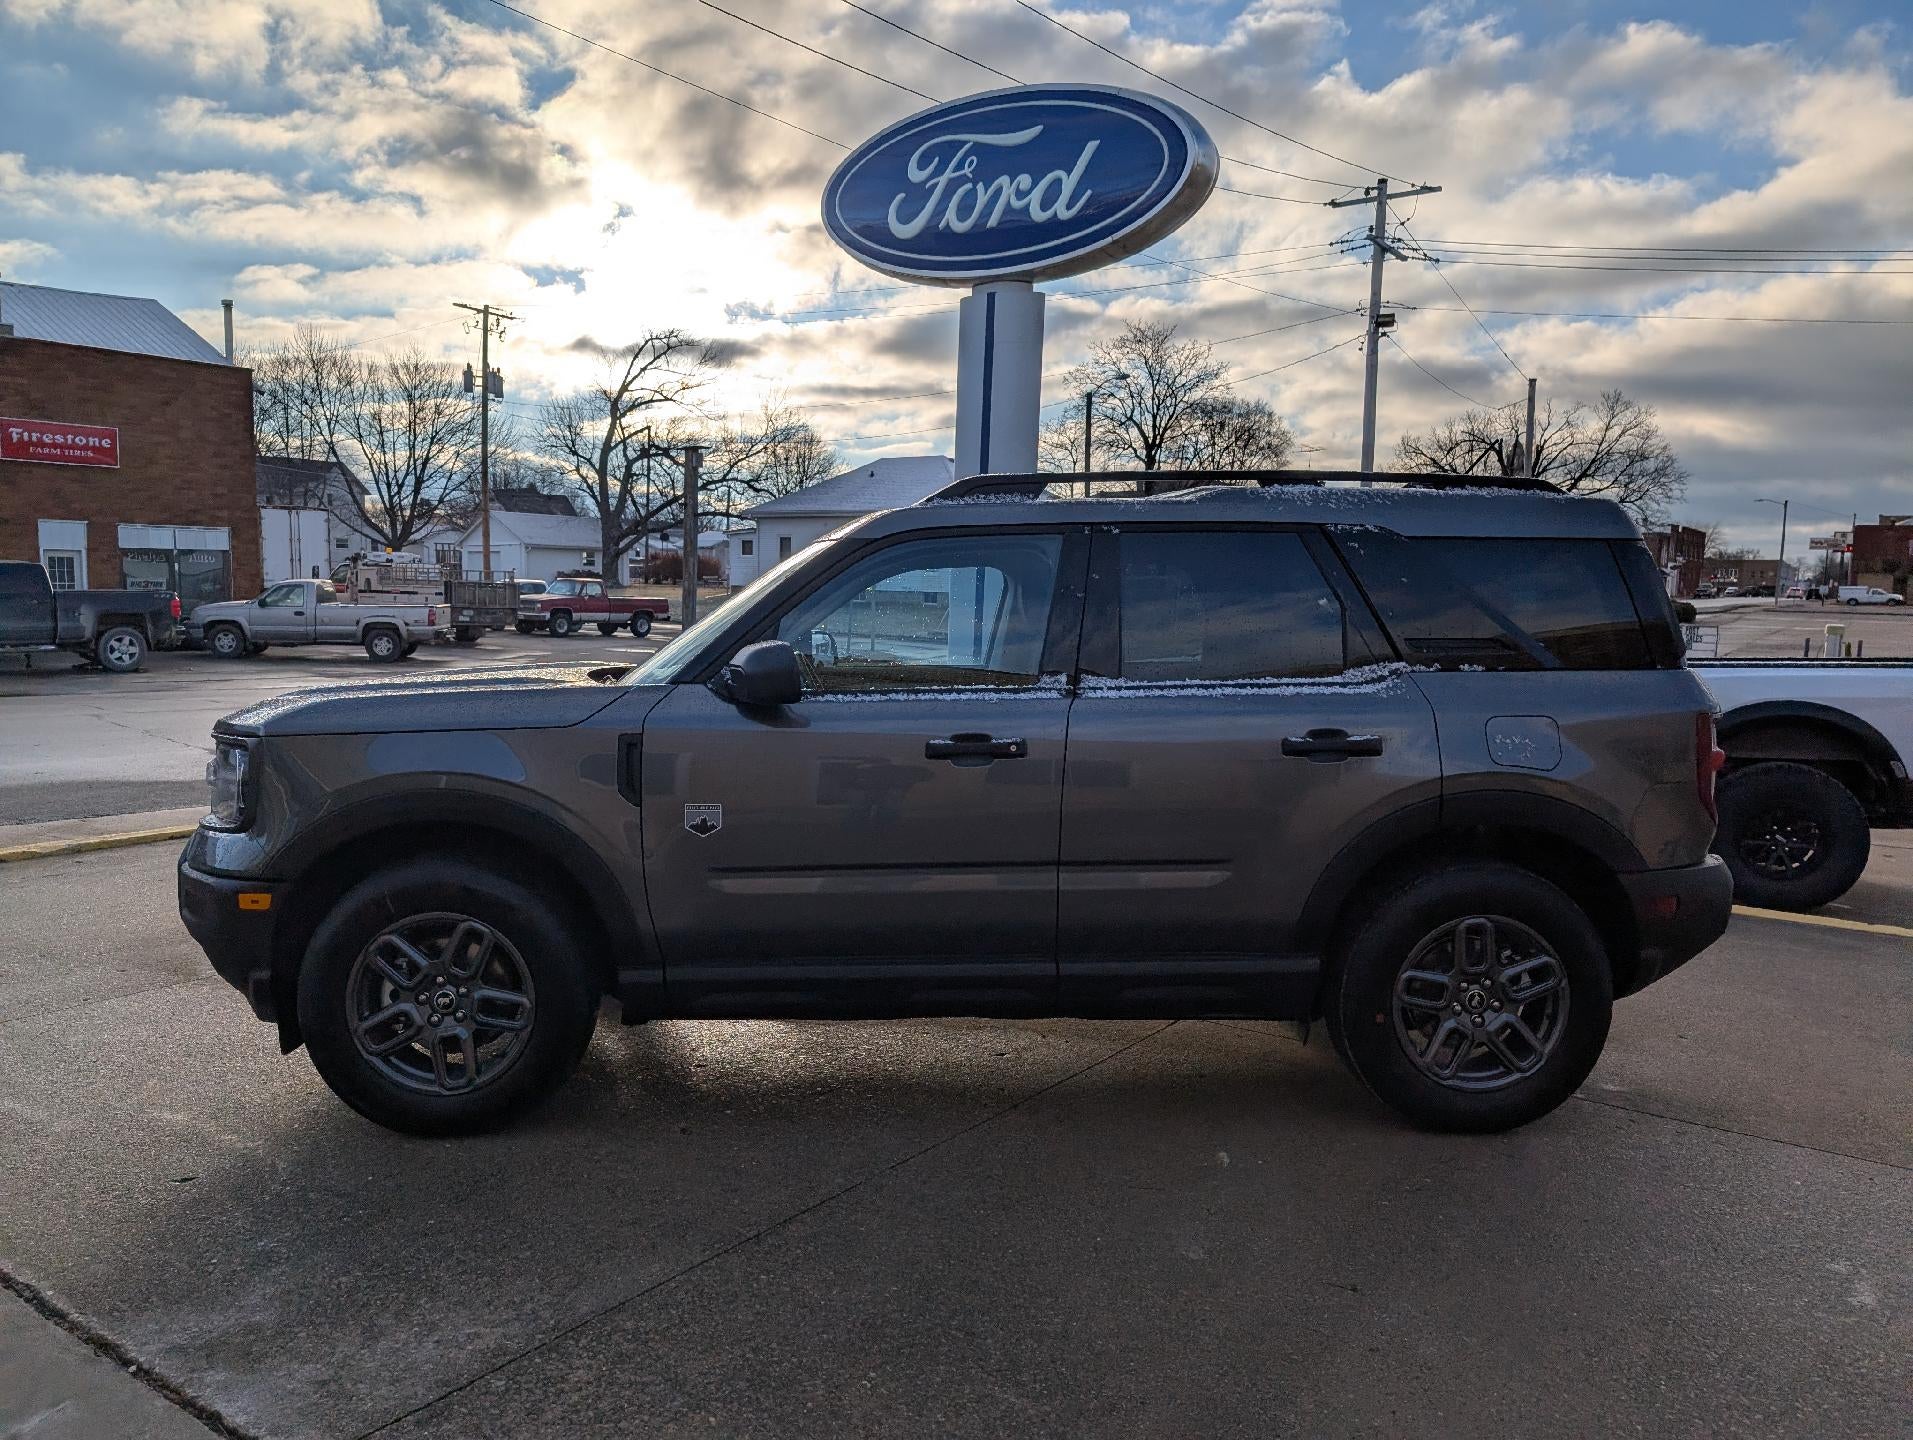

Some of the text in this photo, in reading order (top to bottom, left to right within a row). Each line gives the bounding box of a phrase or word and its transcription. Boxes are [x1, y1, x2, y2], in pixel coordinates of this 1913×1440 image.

[887, 124, 1100, 240] Ford
[8, 427, 112, 448] Firestone
[29, 446, 94, 457] FARM TIRES
